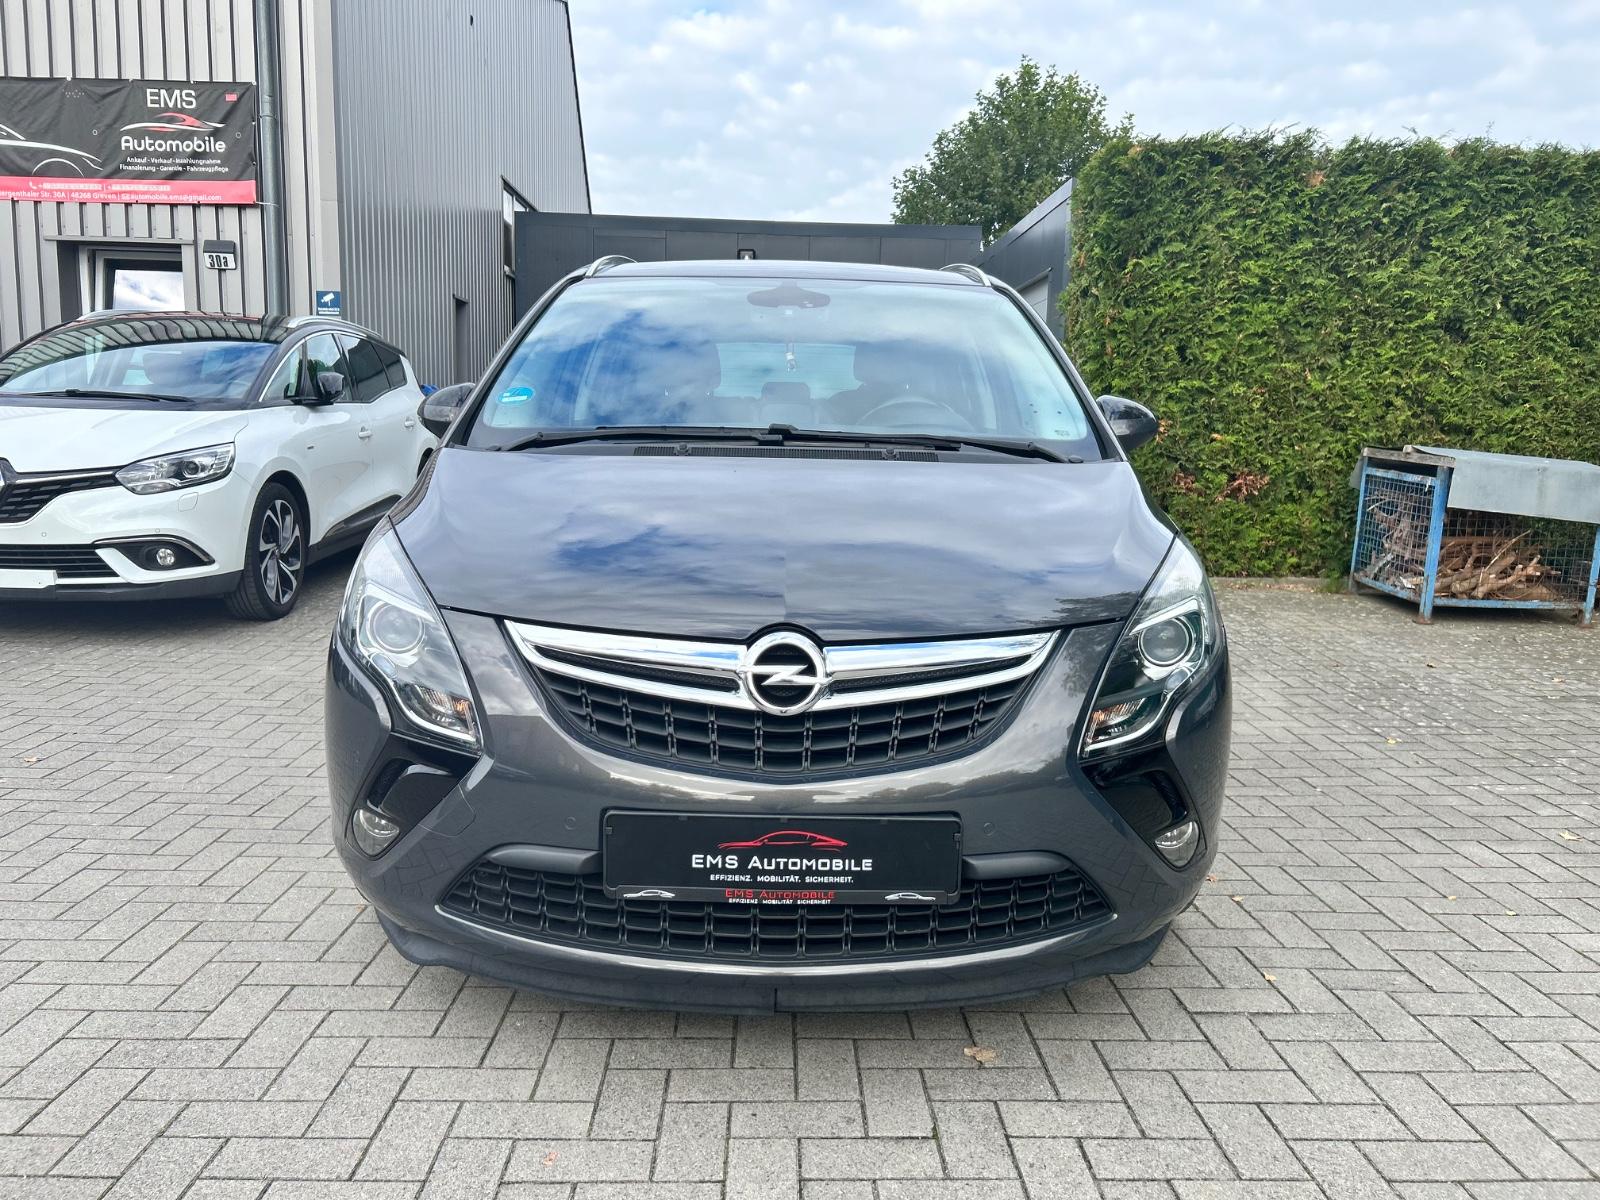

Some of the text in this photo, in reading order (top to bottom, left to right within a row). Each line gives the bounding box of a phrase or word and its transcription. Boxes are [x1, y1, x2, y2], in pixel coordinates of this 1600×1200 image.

[146, 88, 197, 109] EMS
[121, 135, 226, 153] Automobile
[119, 163, 156, 172] Finanzierung
[186, 165, 229, 173] Fahrzeugpflege
[0, 190, 40, 199] ergenthaler
[208, 254, 229, 268] 30a
[691, 854, 873, 871] EMS AUTOMOBILE
[709, 874, 854, 883] EFFIZIENZ. MOBILITÄT. SICHERHEIT.
[725, 888, 835, 899] EMS AUTOMOBILE
